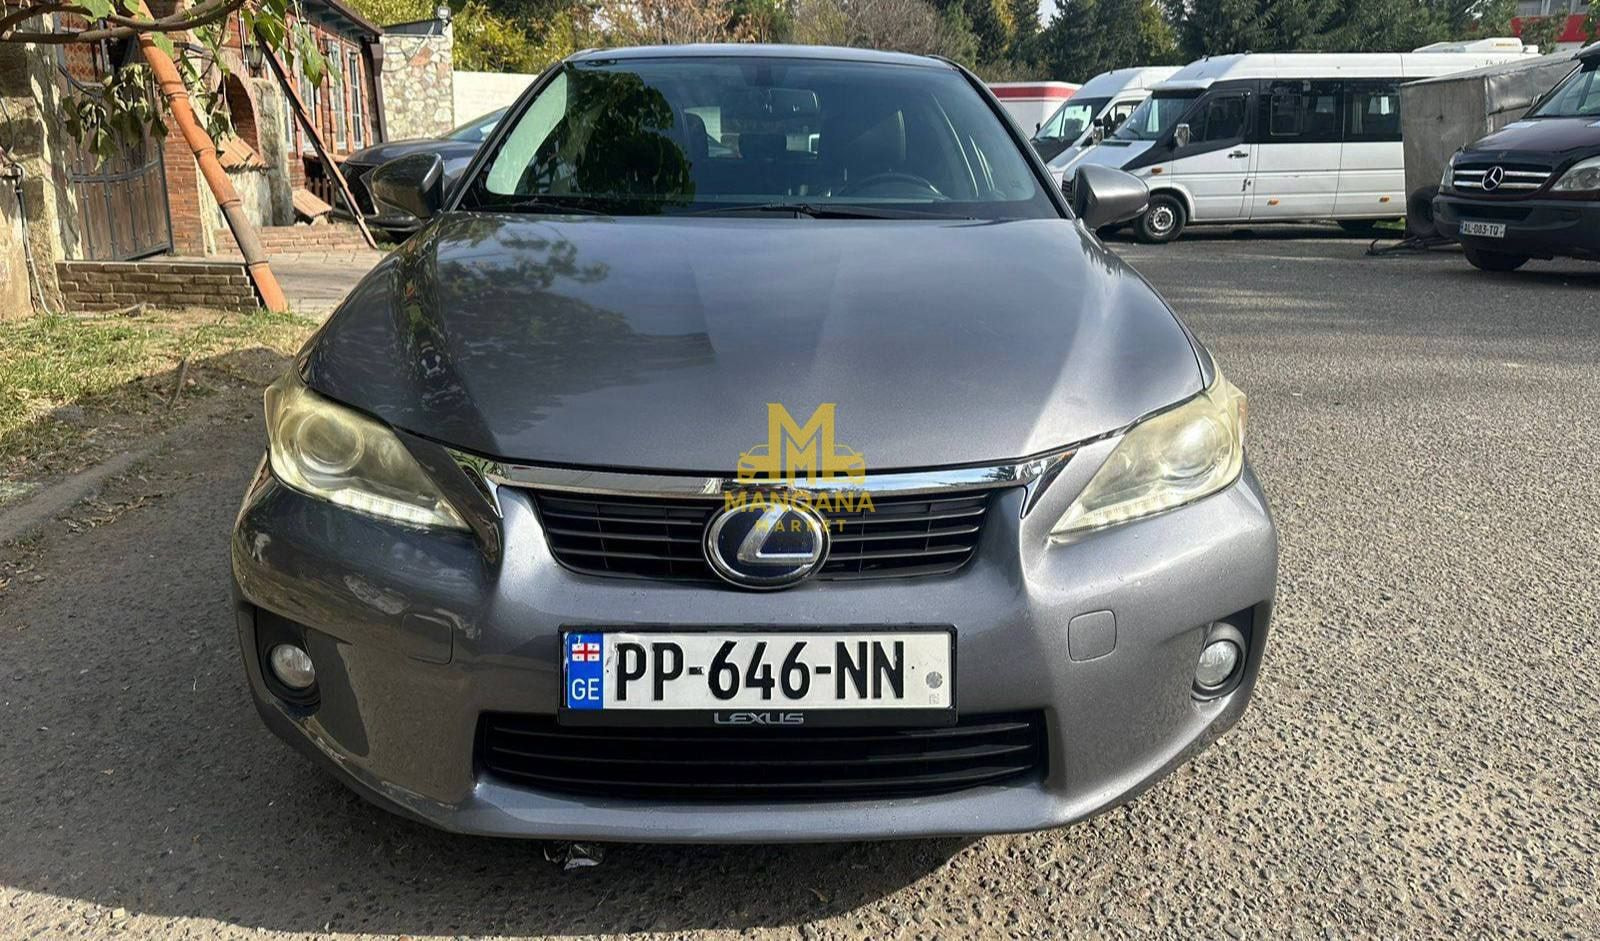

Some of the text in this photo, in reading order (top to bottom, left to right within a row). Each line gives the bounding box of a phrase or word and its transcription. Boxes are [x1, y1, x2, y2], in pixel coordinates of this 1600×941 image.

[614, 640, 905, 701] PP-646-NN
[571, 678, 600, 701] GE
[713, 711, 805, 726] LEXUS
